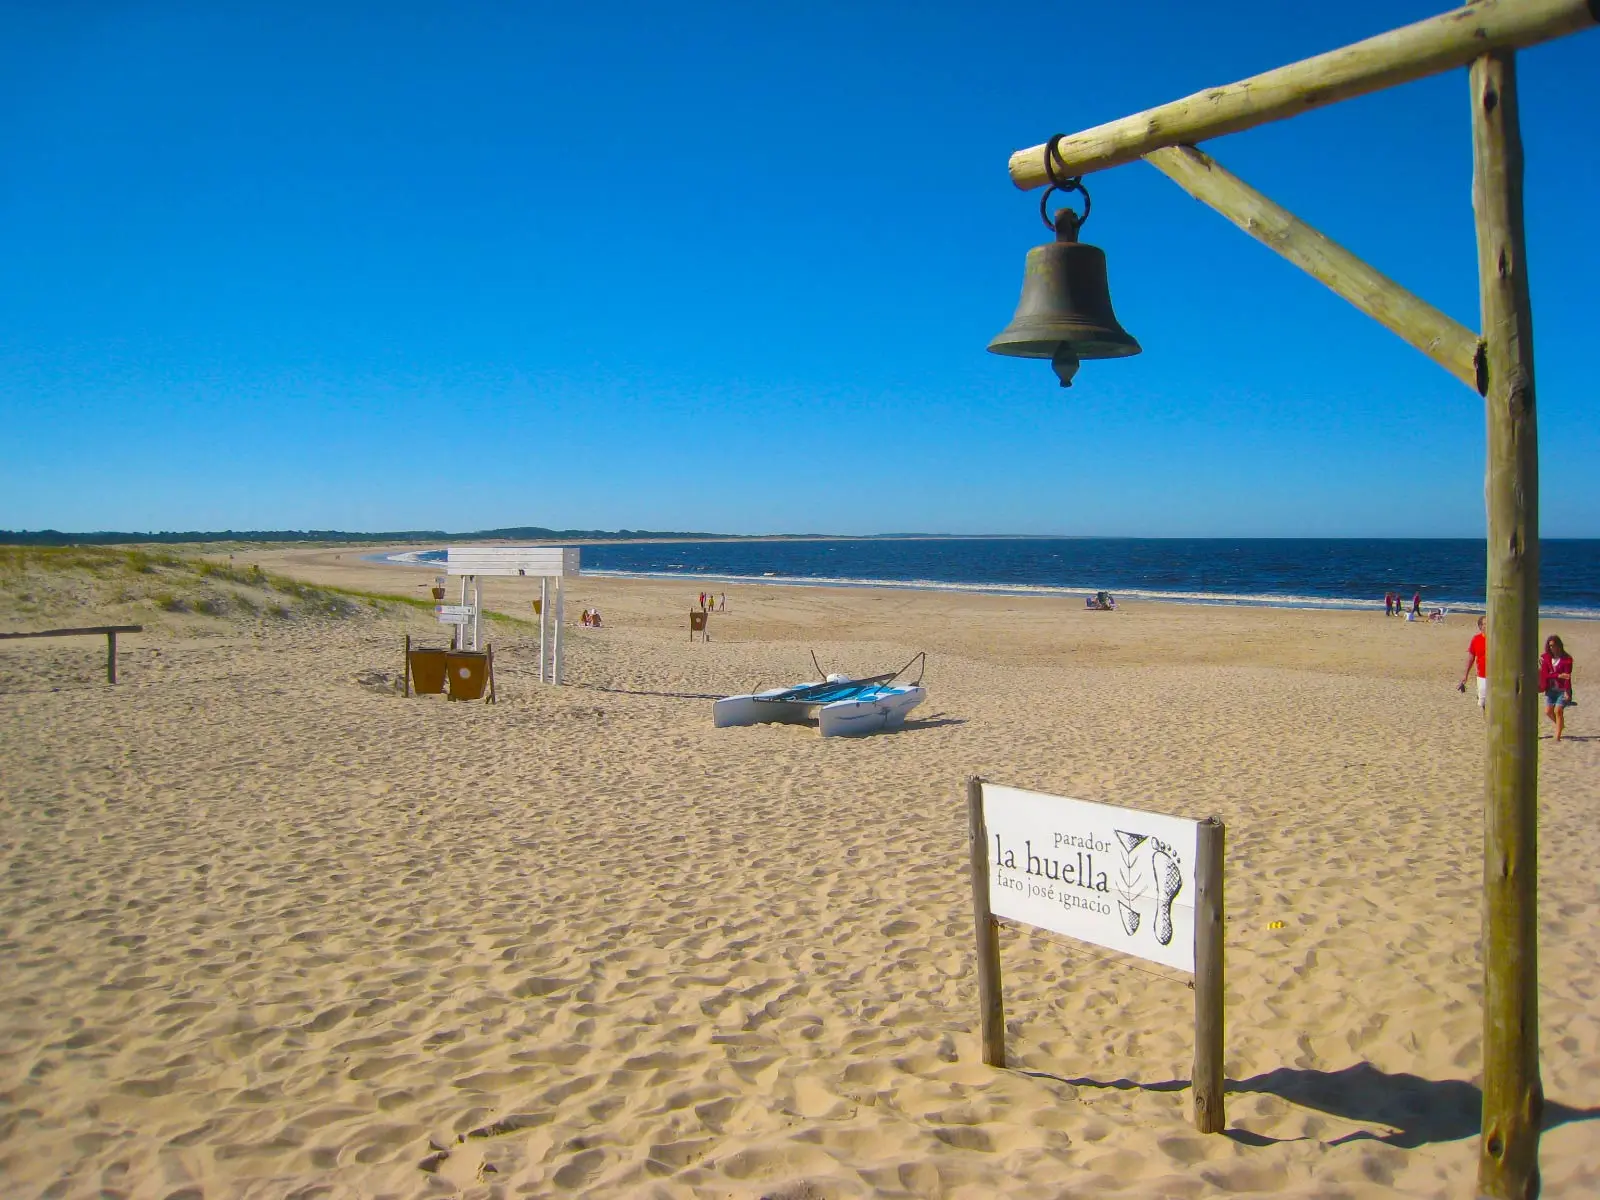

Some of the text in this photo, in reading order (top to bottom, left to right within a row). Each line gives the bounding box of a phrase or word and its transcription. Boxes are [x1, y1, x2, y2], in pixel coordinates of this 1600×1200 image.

[995, 834, 1110, 893] la huella
[1054, 831, 1111, 853] parador
[997, 868, 1111, 916] faro josé ignacio
